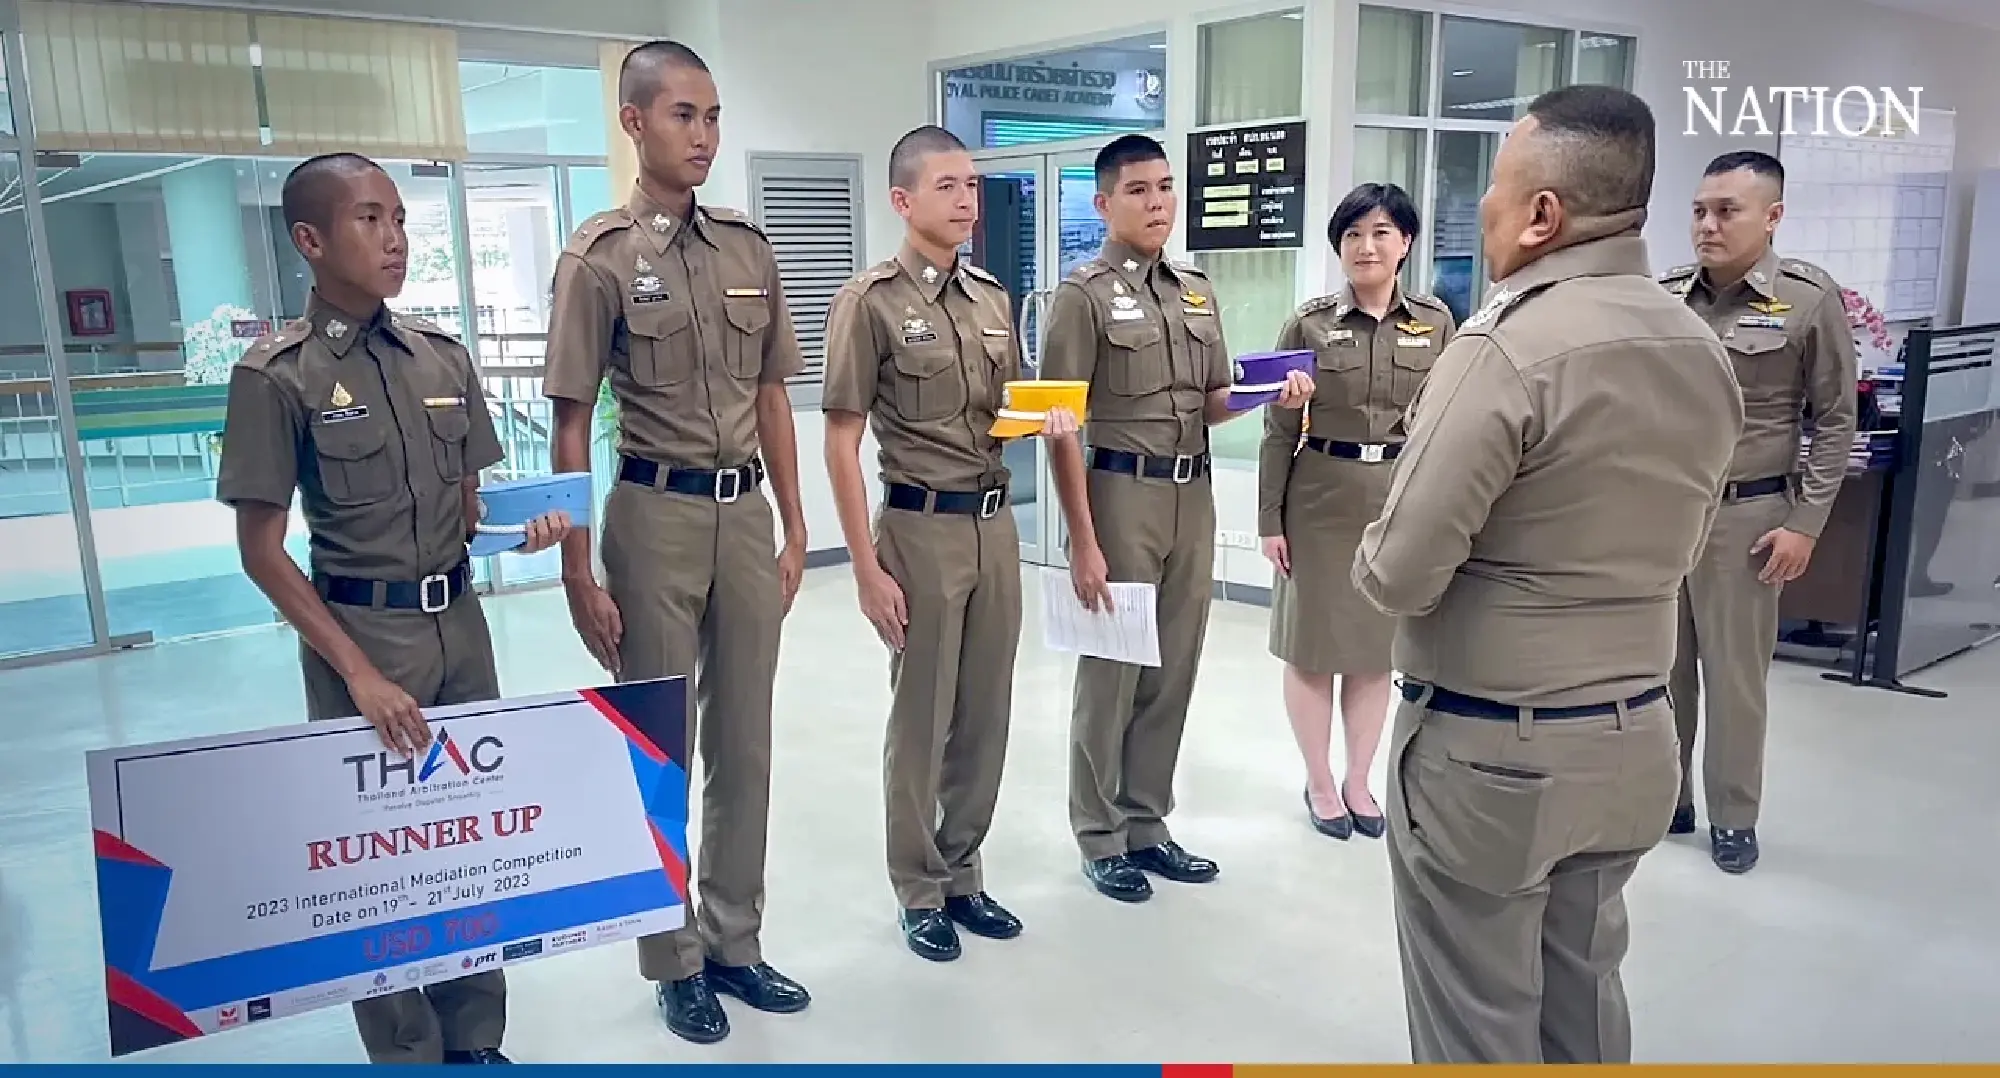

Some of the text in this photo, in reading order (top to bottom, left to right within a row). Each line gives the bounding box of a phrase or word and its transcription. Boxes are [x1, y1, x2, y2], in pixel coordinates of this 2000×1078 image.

[342, 726, 504, 793] THAC
[357, 774, 504, 803] Thailand Arbitration Center
[306, 804, 543, 871] RUNNER UP
[247, 845, 582, 920] 2023 International Mediation Competition
[312, 910, 352, 929] Date
[358, 905, 378, 920] on
[452, 883, 484, 901] July
[494, 872, 531, 893] 2023
[363, 912, 499, 963] USD 700
